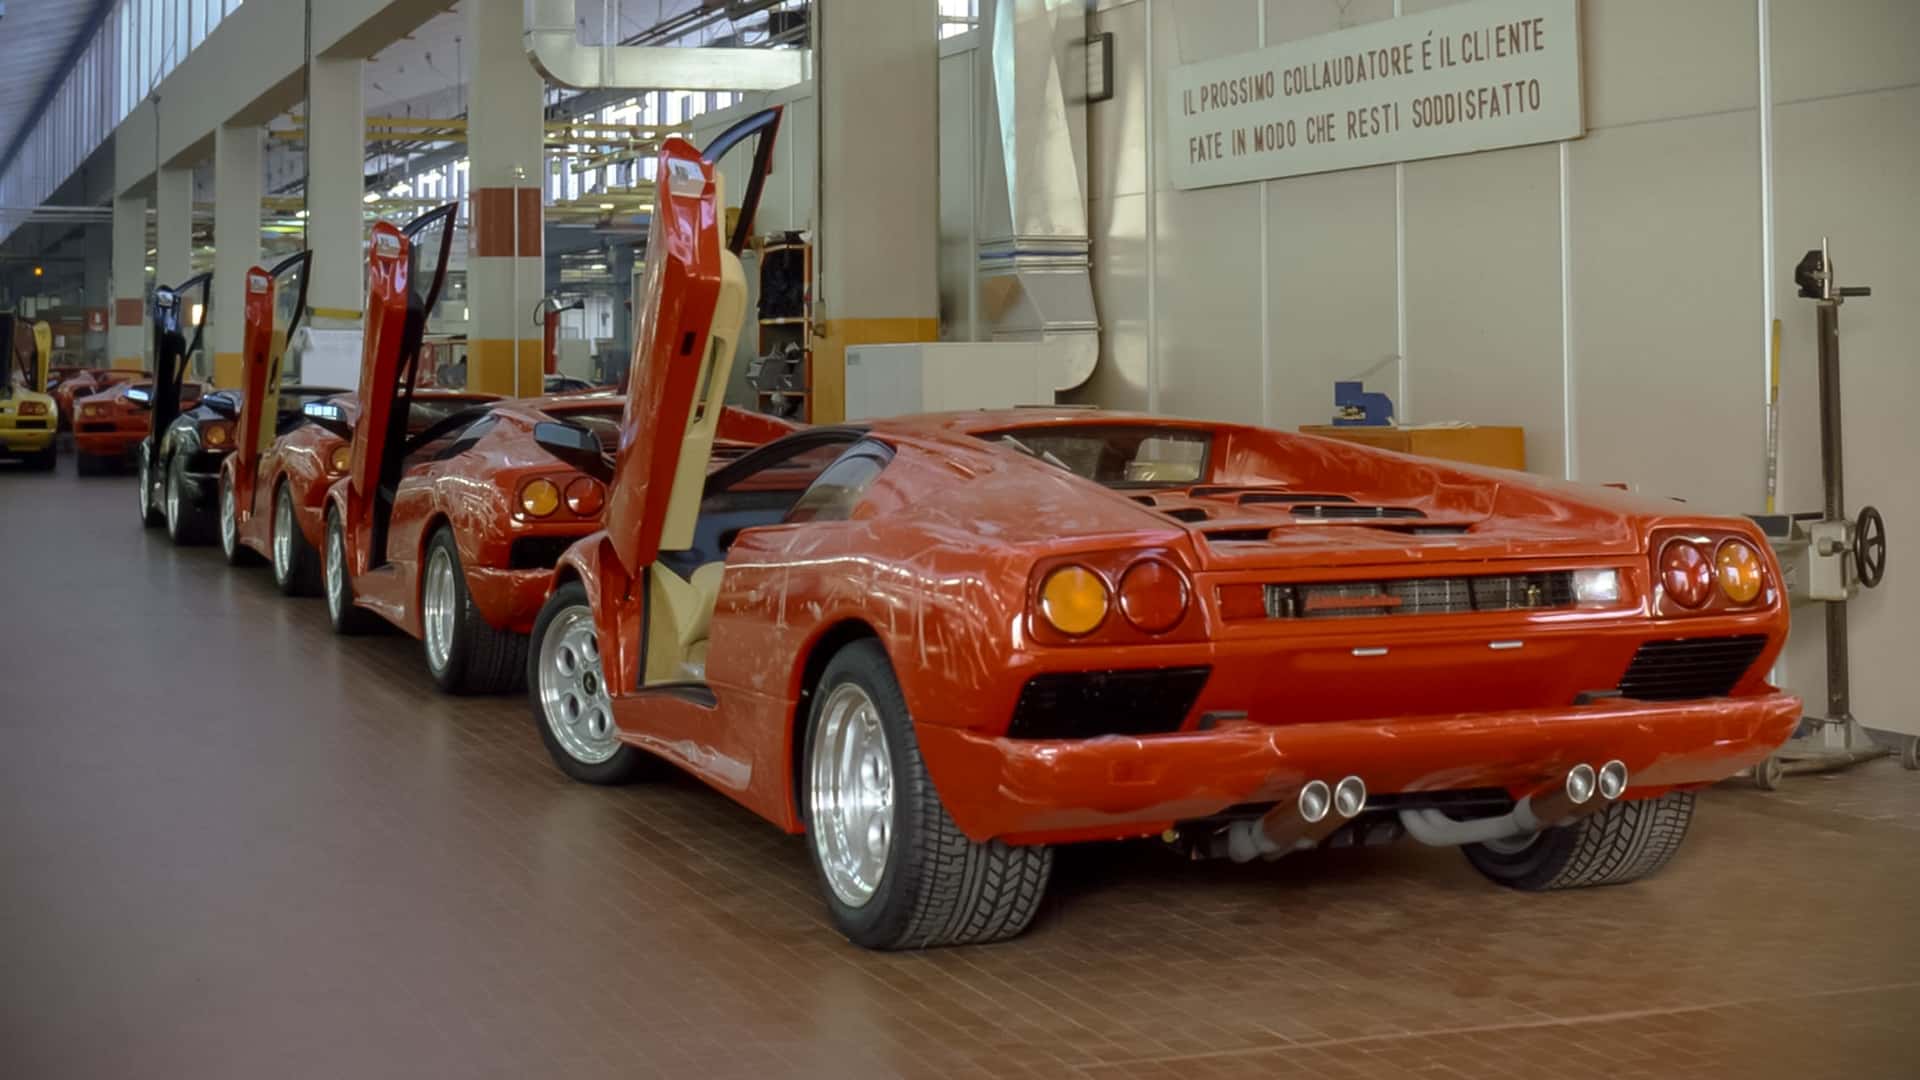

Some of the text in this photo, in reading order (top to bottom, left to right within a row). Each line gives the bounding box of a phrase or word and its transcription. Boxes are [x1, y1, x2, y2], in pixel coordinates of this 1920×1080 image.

[1183, 89, 1197, 116] IL
[1200, 70, 1275, 113] PROSSIMO
[1283, 43, 1414, 97] COLLAUDATORE
[1439, 36, 1456, 68] IL
[1461, 17, 1545, 64] CLIENTE
[1189, 78, 1541, 164] FATE IN MODO CHE RESTI SODDISFATTO
